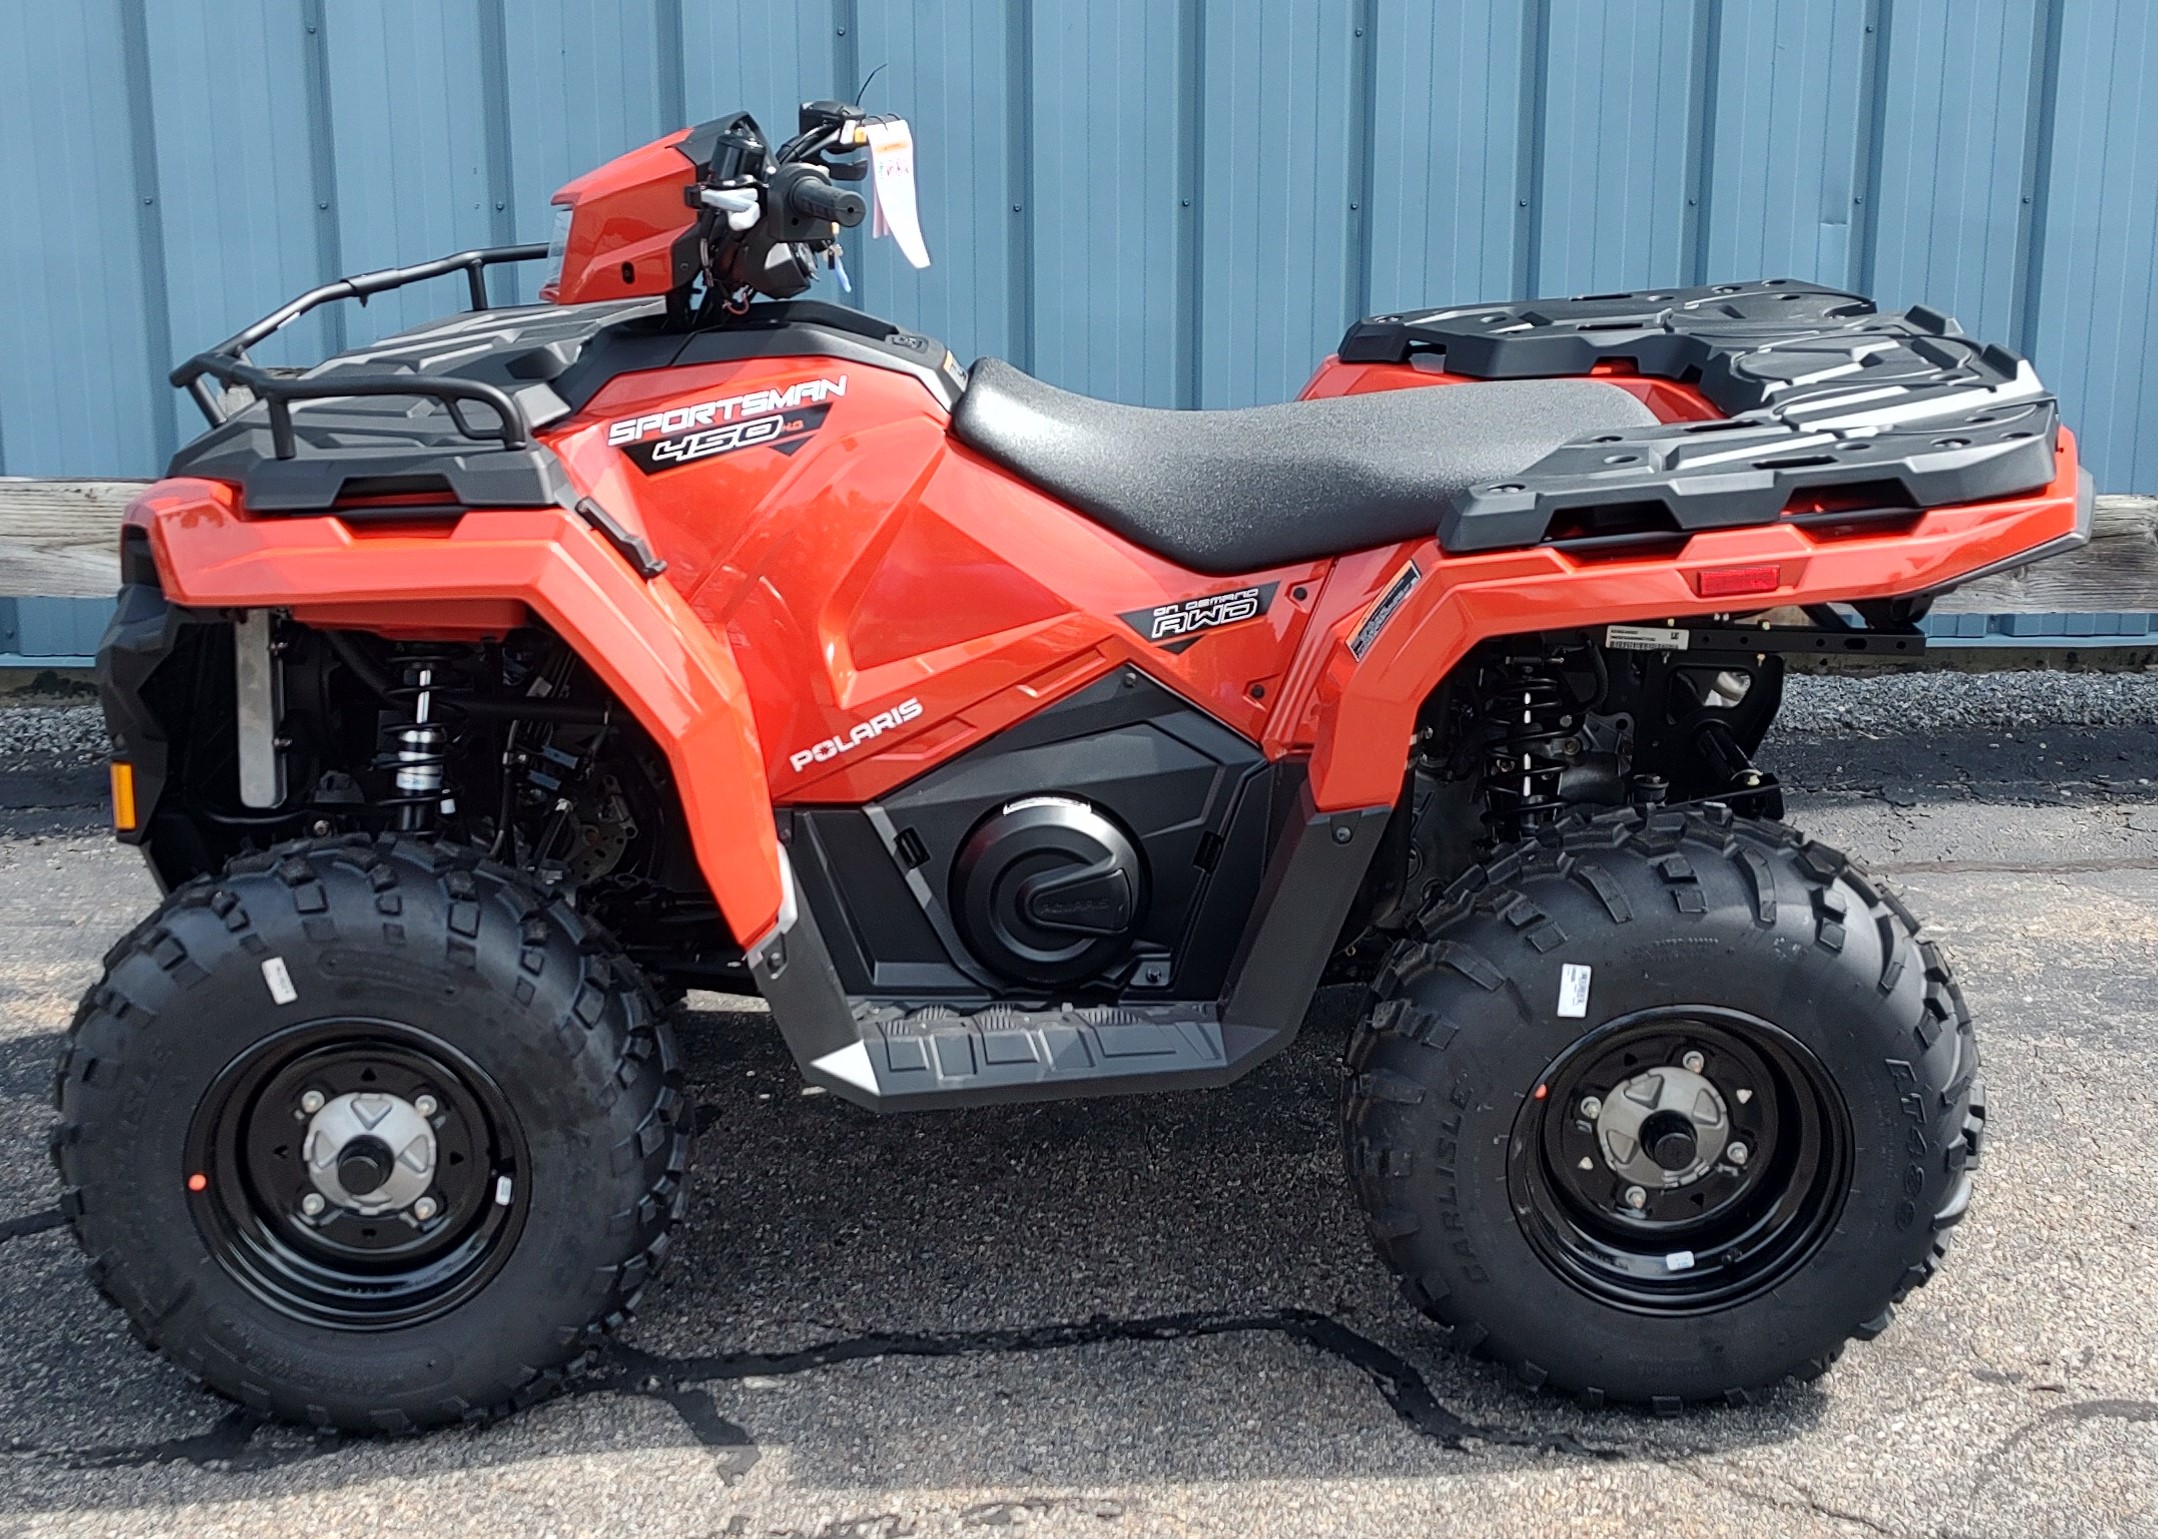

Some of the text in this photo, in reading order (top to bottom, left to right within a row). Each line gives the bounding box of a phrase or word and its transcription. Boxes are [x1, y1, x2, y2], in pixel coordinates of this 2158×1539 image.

[608, 375, 848, 446] SPORTSMAN
[651, 415, 784, 462] 450
[1151, 598, 1258, 639] AWD
[1153, 588, 1259, 616] ON DEMAND
[789, 697, 924, 772] POLARIS
